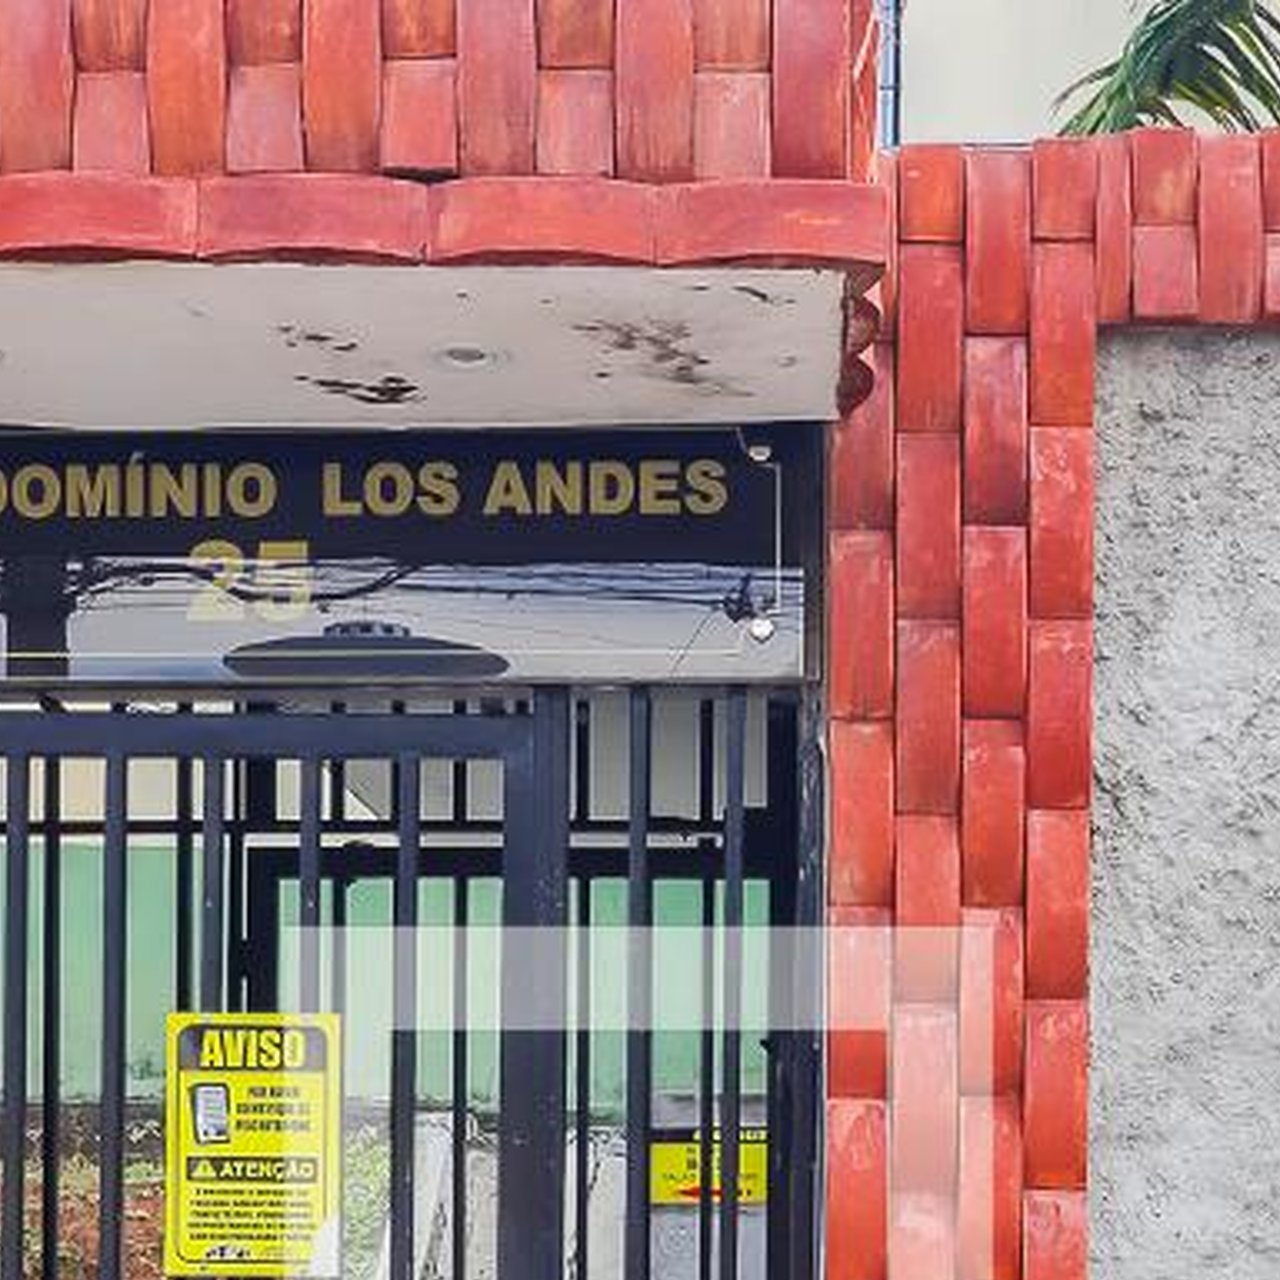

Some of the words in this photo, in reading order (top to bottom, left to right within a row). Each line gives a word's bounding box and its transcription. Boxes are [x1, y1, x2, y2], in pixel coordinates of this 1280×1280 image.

[322, 460, 459, 517] LOS
[484, 459, 729, 516] ANDES
[187, 539, 311, 622] 25
[199, 1029, 307, 1069] AVISO
[220, 1158, 315, 1182] ATENÇÃO
